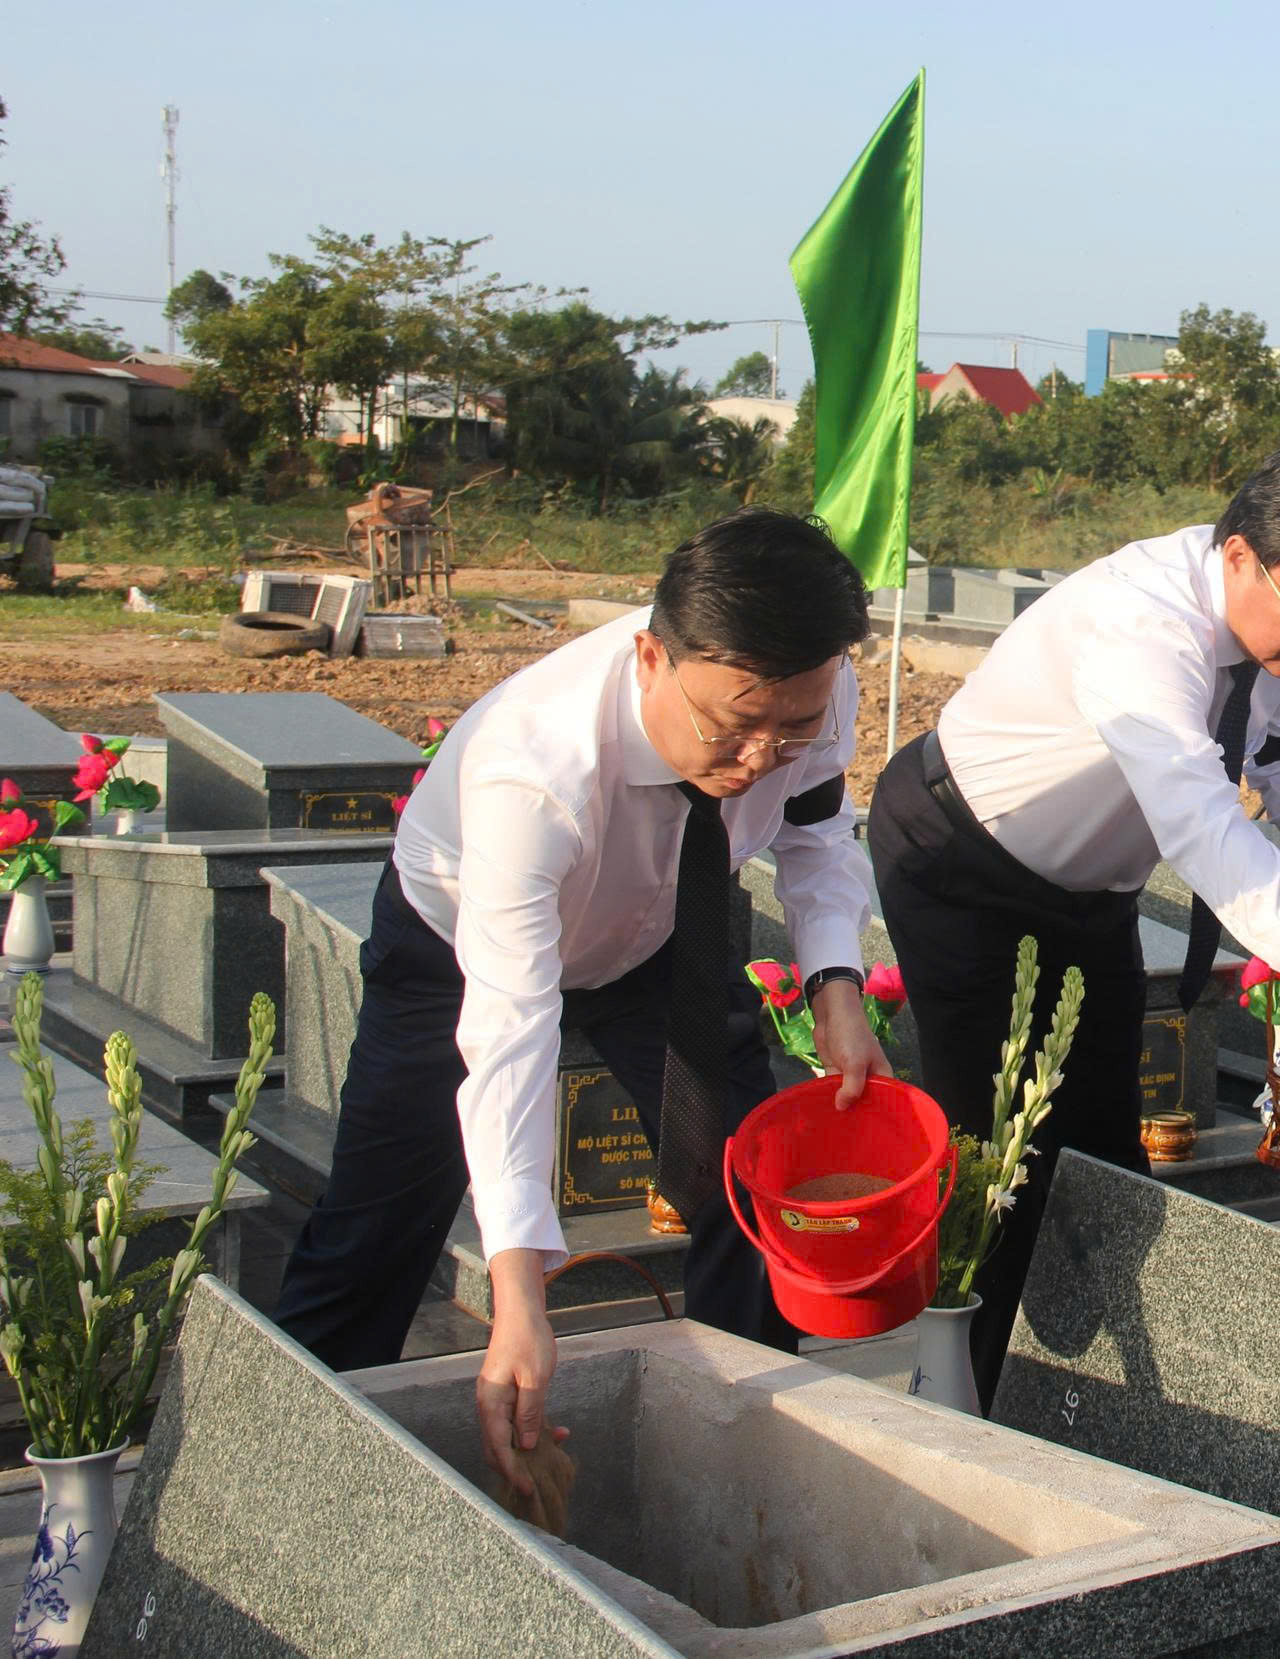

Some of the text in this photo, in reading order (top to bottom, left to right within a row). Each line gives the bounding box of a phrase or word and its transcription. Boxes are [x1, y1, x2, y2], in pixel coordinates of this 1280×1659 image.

[577, 1136, 594, 1151] MỘ
[596, 1134, 619, 1150] LIỆT
[621, 1132, 632, 1146] SĨ
[601, 1145, 655, 1164] ĐƯỢC THÔ
